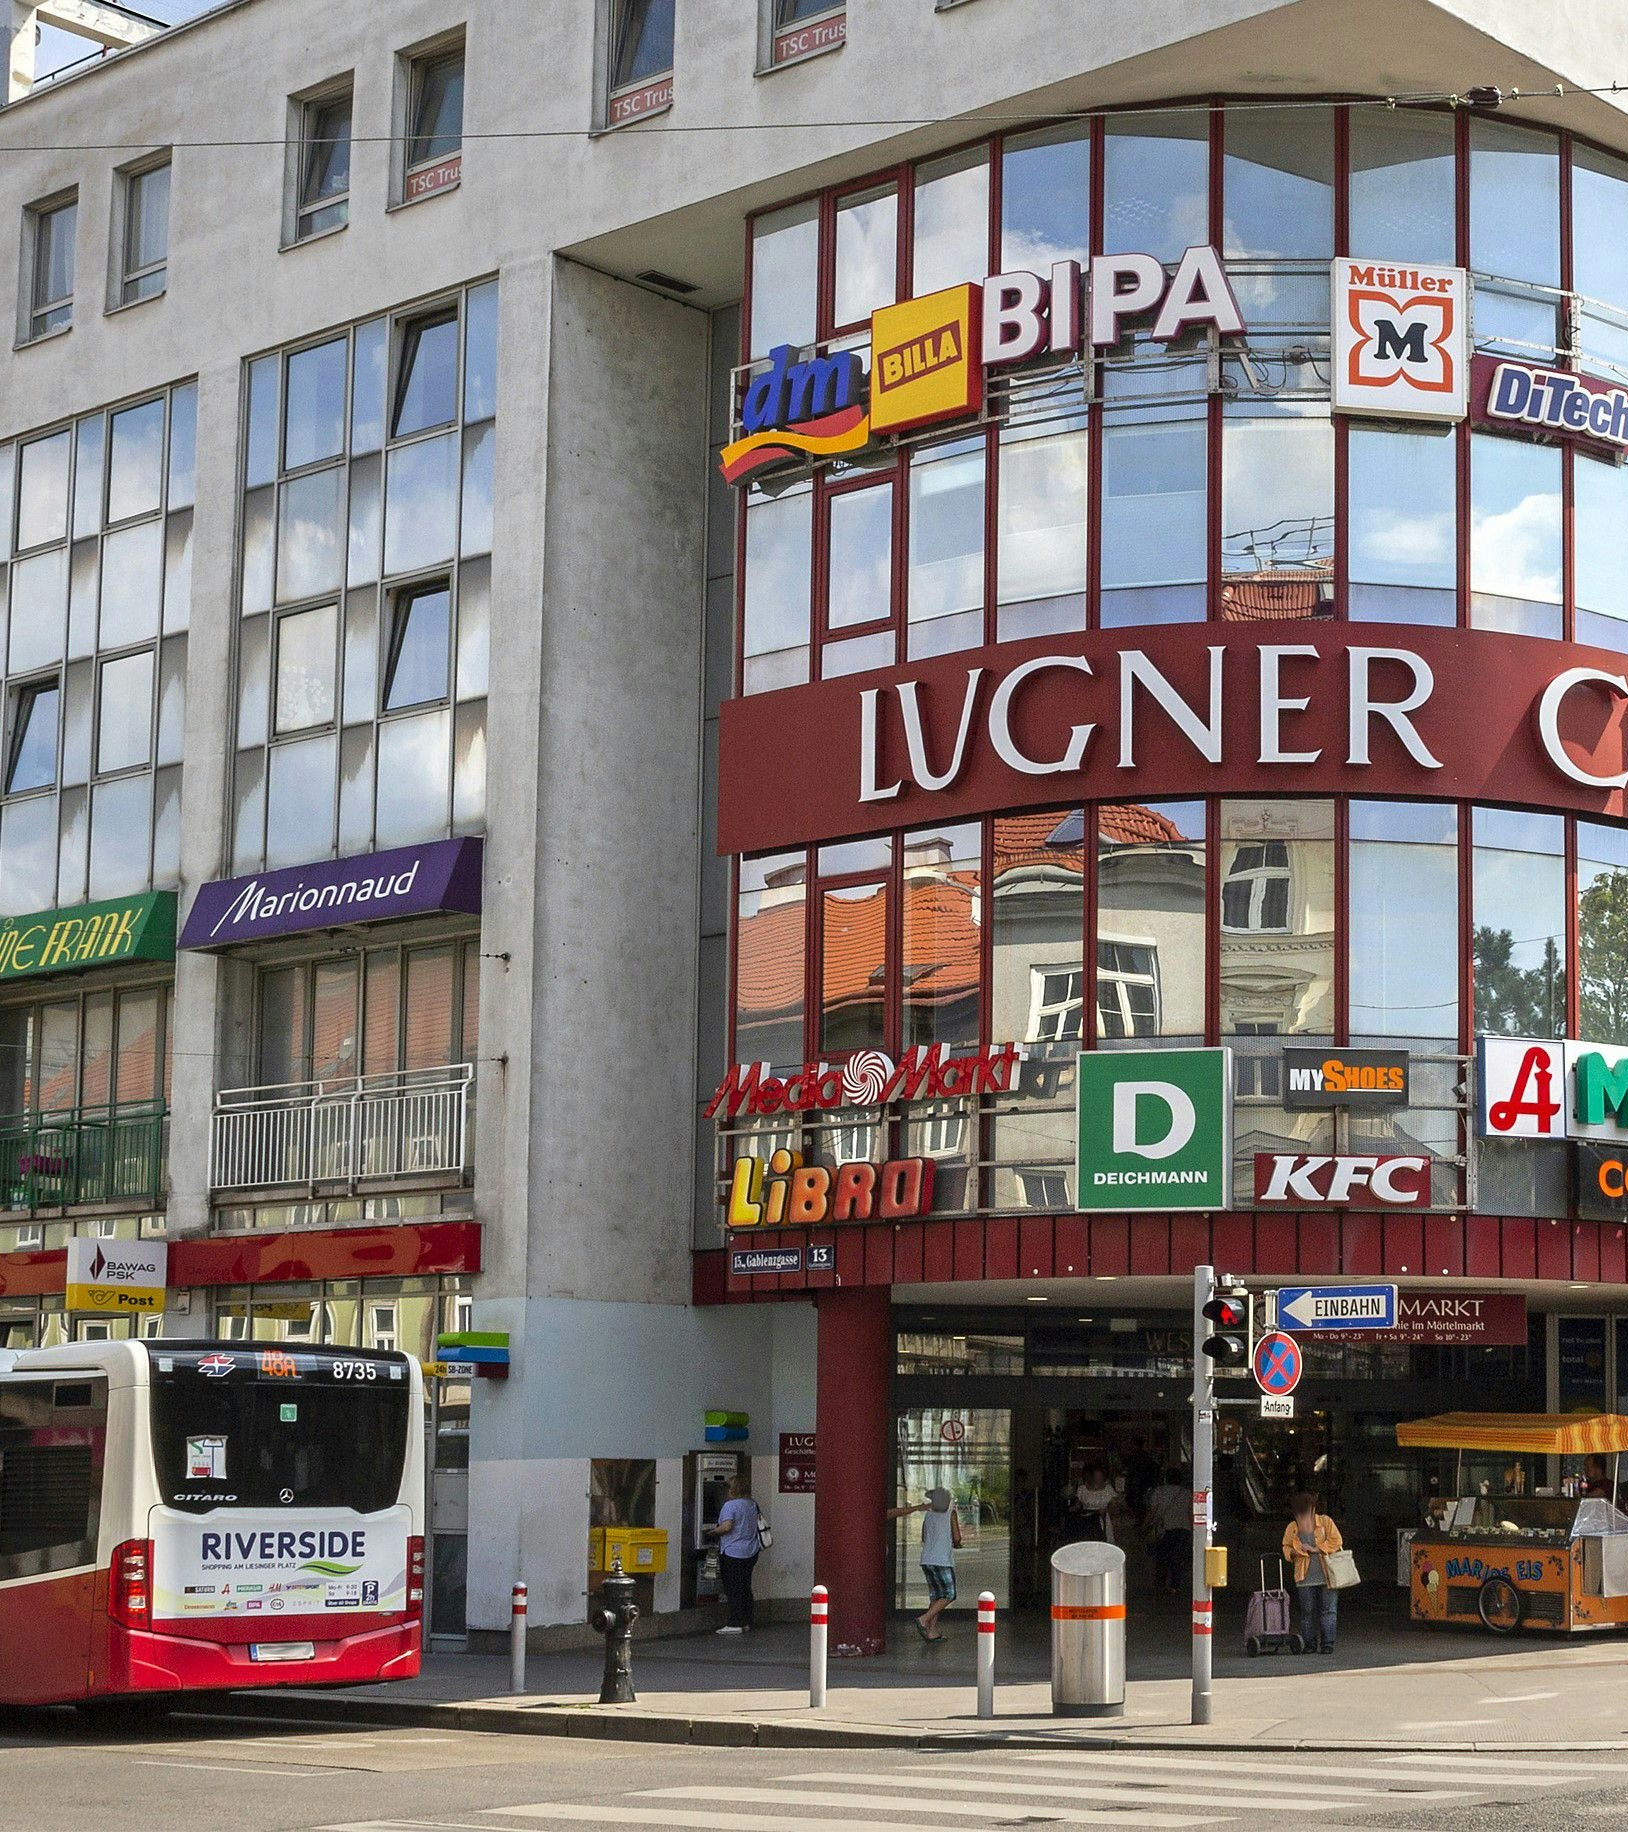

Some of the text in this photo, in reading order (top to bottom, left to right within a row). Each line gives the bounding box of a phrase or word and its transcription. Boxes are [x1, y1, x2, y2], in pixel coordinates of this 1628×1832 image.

[780, 22, 846, 57] TSC Trus
[613, 86, 673, 118] TSC Trus
[410, 166, 462, 194] TSC Tru
[1348, 264, 1454, 295] Müller
[981, 244, 1247, 366] BIPA
[1373, 319, 1429, 364] M
[883, 330, 961, 387] BILLA
[742, 343, 860, 432] dm
[858, 643, 1445, 803] LUGNER
[210, 860, 420, 938] Marionnaud
[38, 907, 143, 967] FRANK
[1111, 1081, 1196, 1160] D
[1093, 1169, 1209, 1186] DEICHMANN
[1259, 1154, 1426, 1203] KFC
[746, 1253, 799, 1270] Gablenzgasse
[812, 1248, 828, 1262] 13
[106, 1261, 156, 1273] BAWAG
[106, 1270, 135, 1280] PSK
[118, 1293, 154, 1306] Post
[1314, 1297, 1381, 1318] EINBAHN
[1398, 1299, 1484, 1317] MARKT
[1427, 1320, 1486, 1331] Mörtelmarkt
[332, 1361, 377, 1381] 8735
[1265, 1400, 1291, 1414] Anfang
[789, 1436, 815, 1447] LUG
[173, 1493, 238, 1501] CITARO
[201, 1530, 366, 1561] RIVERSIDE
[201, 1563, 233, 1571] SHOPPING
[245, 1562, 276, 1570] LIESINGER
[1516, 1560, 1543, 1581] EIS
